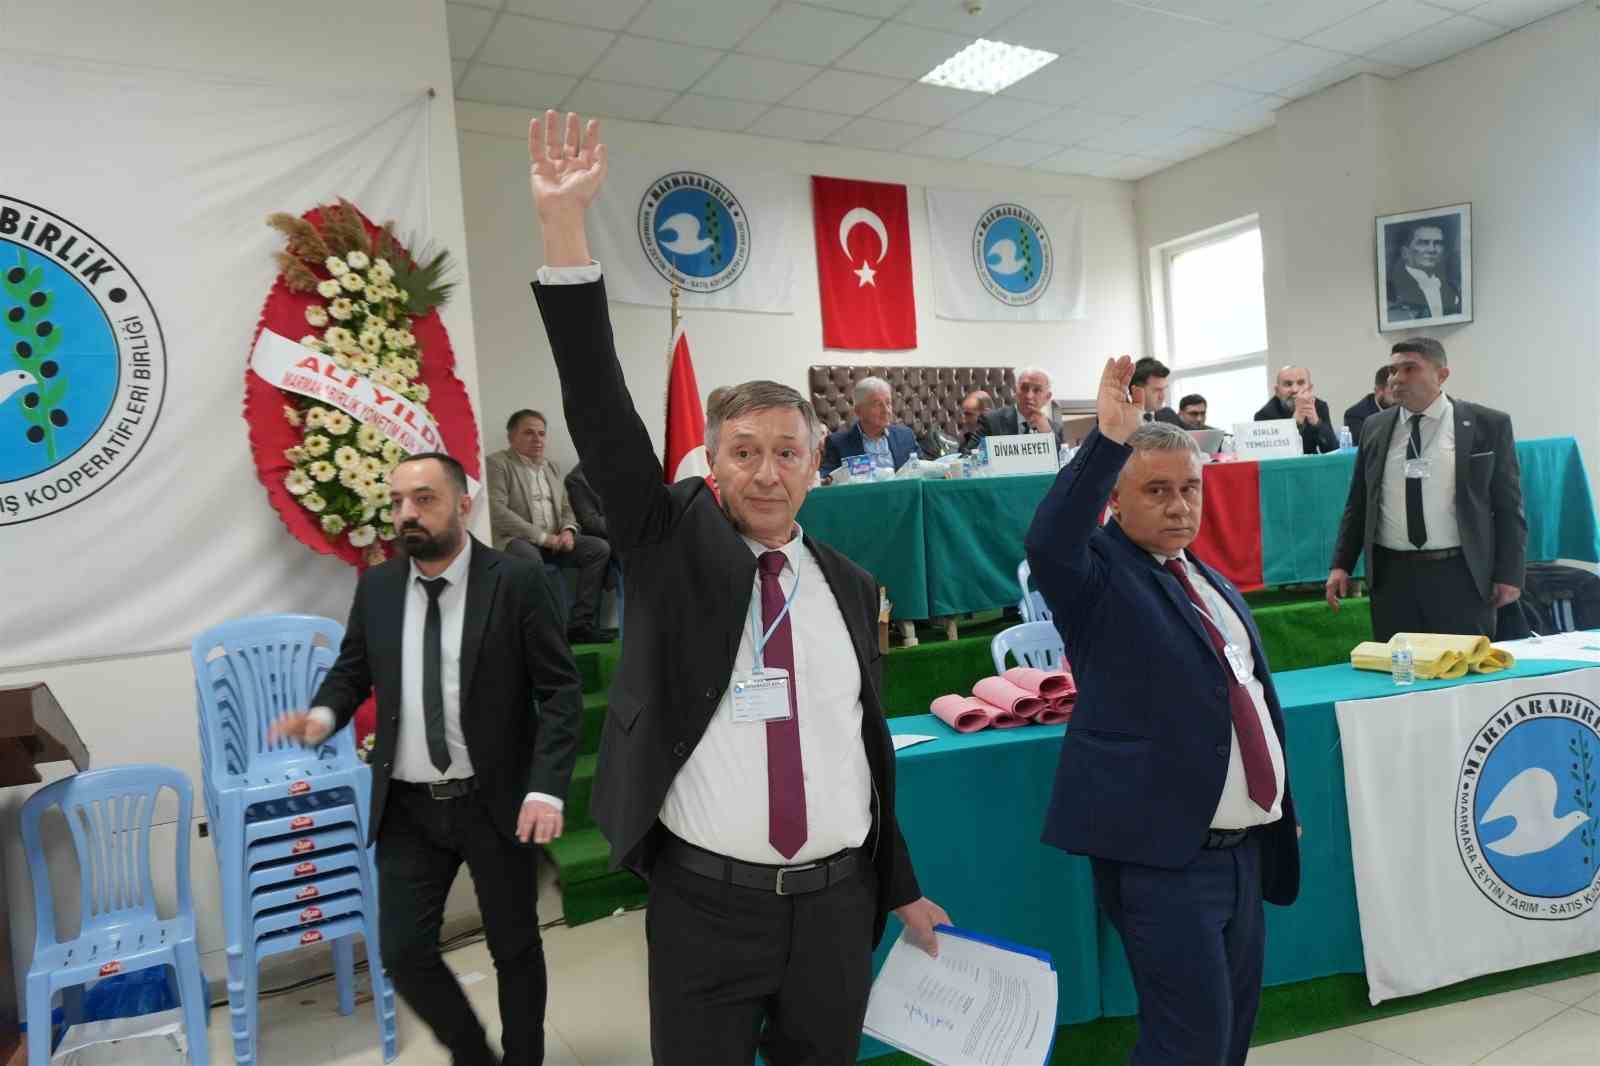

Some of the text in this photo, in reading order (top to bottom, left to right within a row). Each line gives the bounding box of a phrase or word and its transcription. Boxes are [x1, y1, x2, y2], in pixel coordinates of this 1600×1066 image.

[24, 384, 150, 507] KOOPERATİFLERİ
[119, 315, 152, 381] BİRLİĞİ
[1460, 792, 1480, 863] MARMARA
[1506, 894, 1539, 913] TARIM
